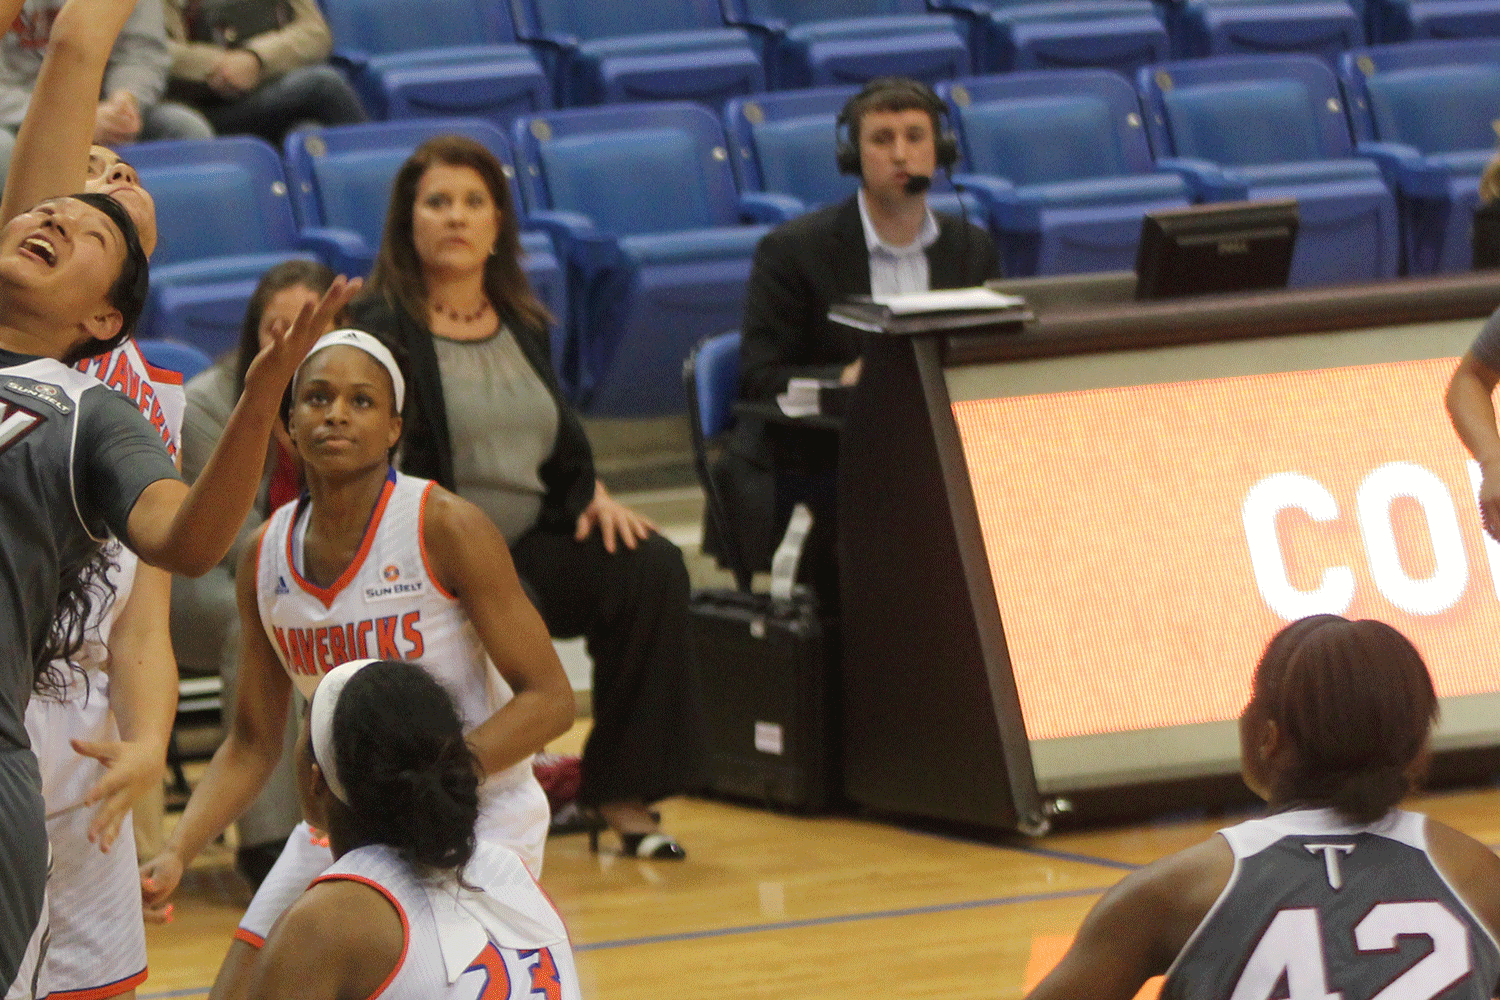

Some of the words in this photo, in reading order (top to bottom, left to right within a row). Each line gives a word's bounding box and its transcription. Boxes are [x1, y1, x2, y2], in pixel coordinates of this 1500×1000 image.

[1241, 460, 1500, 622] CO
[365, 587, 392, 598] SUN
[394, 582, 422, 594] BELT
[1303, 843, 1356, 890] T
[1228, 900, 1473, 1000] 42
